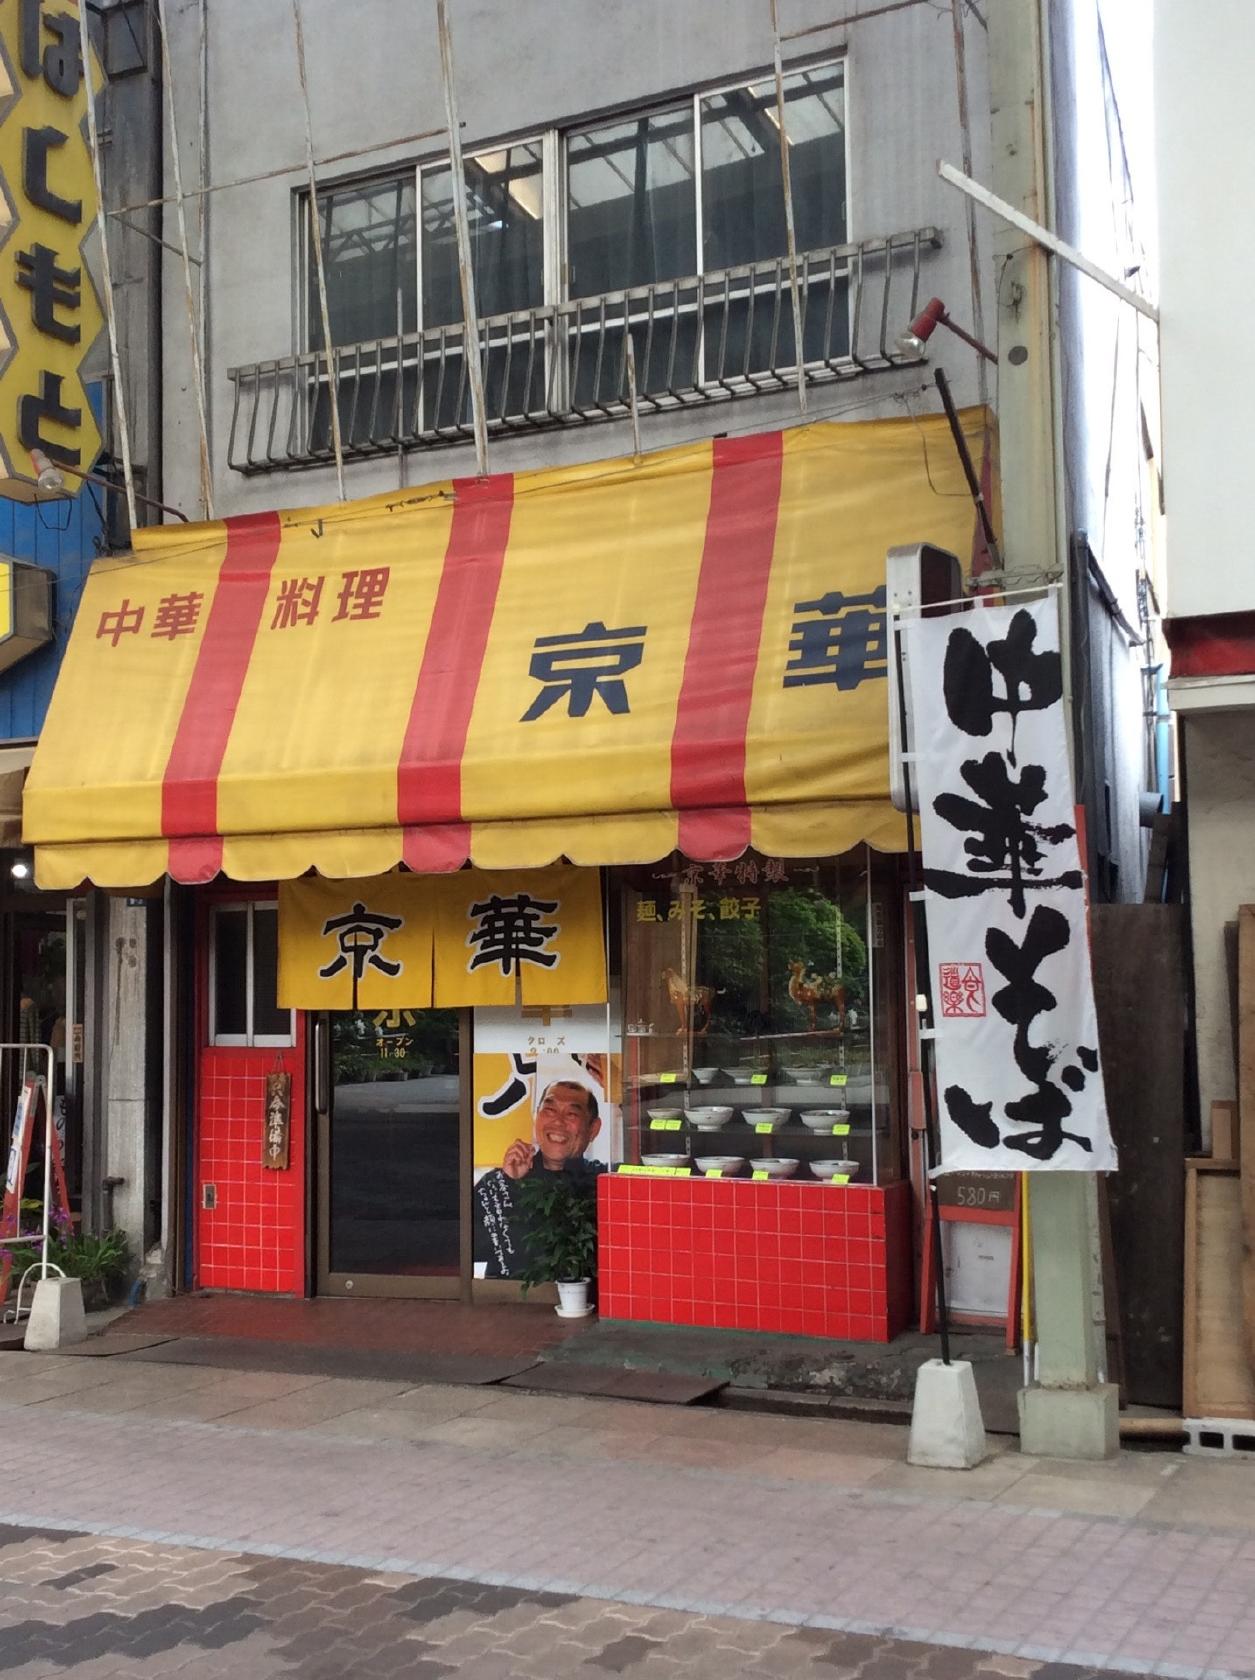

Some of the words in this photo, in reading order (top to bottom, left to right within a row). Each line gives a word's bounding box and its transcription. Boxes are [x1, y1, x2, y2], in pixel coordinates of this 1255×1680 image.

[519, 585, 887, 722] 京華
[319, 895, 559, 978] 京華
[924, 608, 1099, 1160] 中華そば
